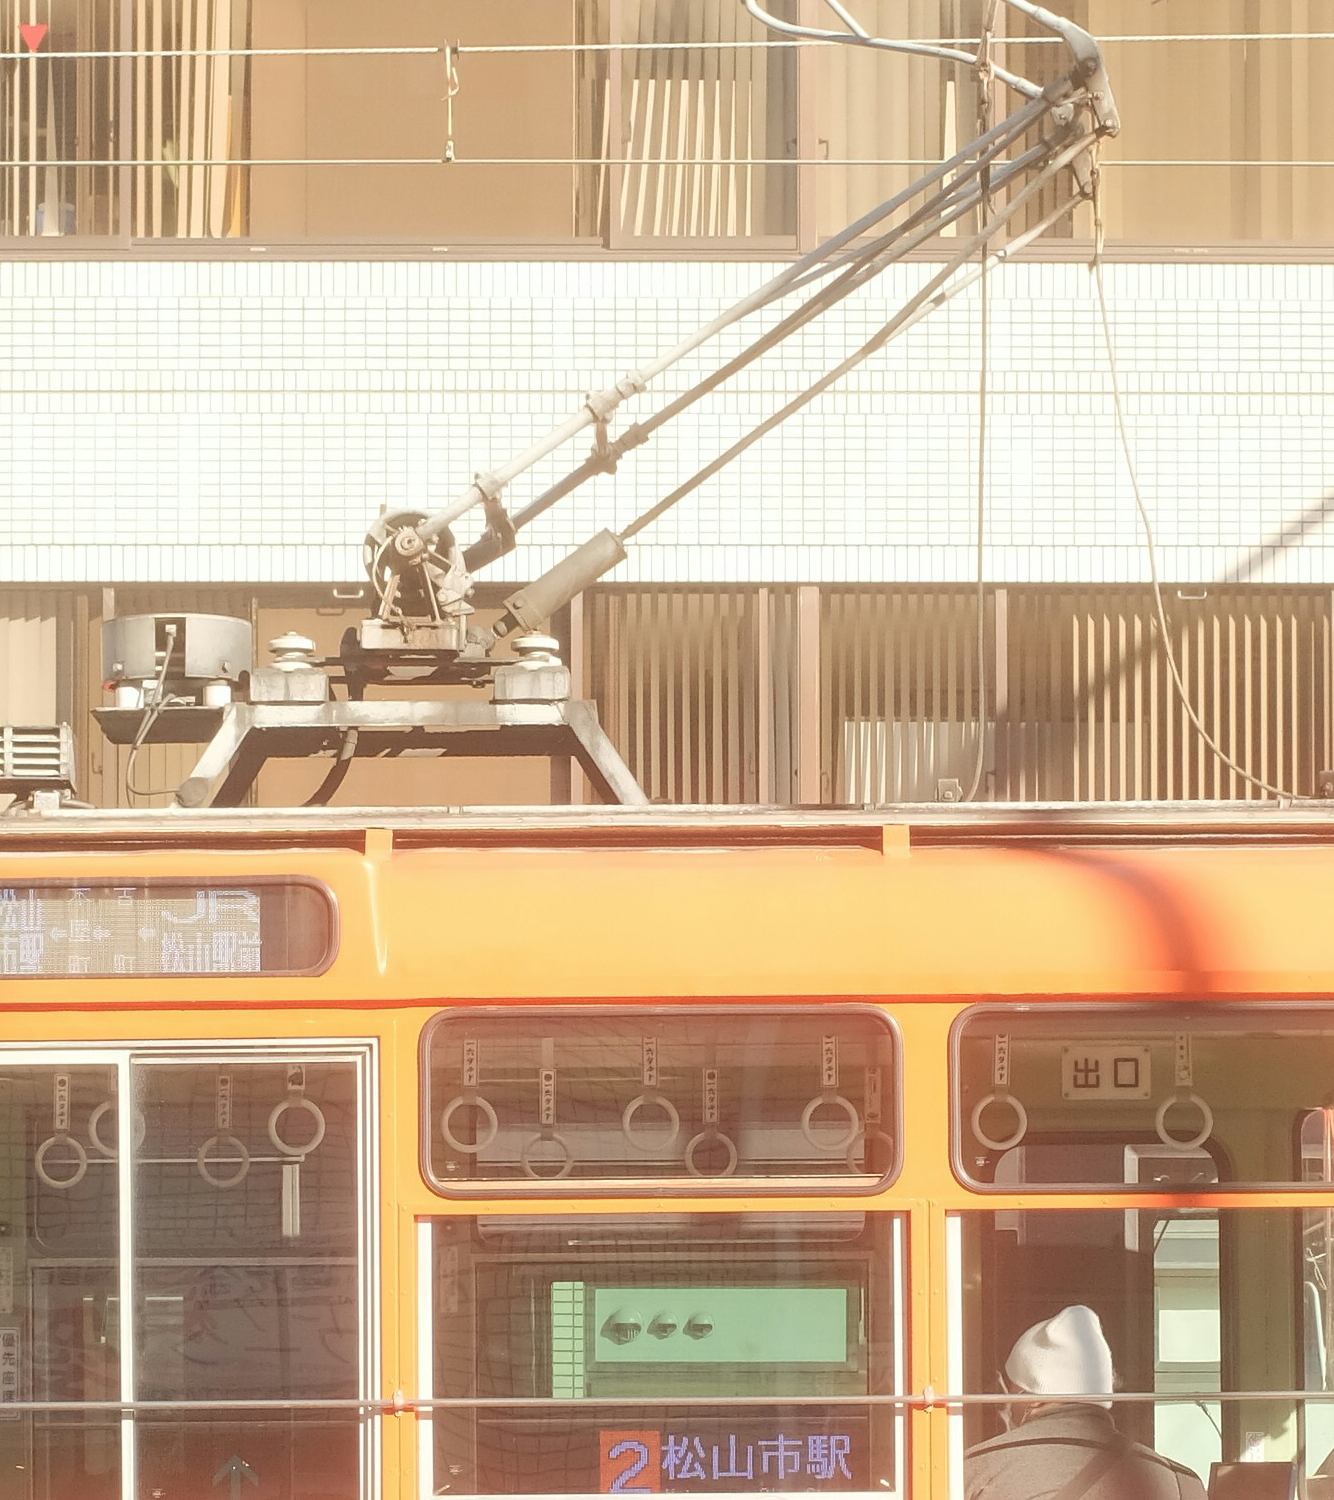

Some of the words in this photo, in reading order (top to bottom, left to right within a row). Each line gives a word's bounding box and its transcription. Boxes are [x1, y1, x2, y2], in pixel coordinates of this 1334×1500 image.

[1073, 1057, 1140, 1088] 出口
[608, 1440, 652, 1493] 2
[661, 1434, 852, 1480] 松山市駅
